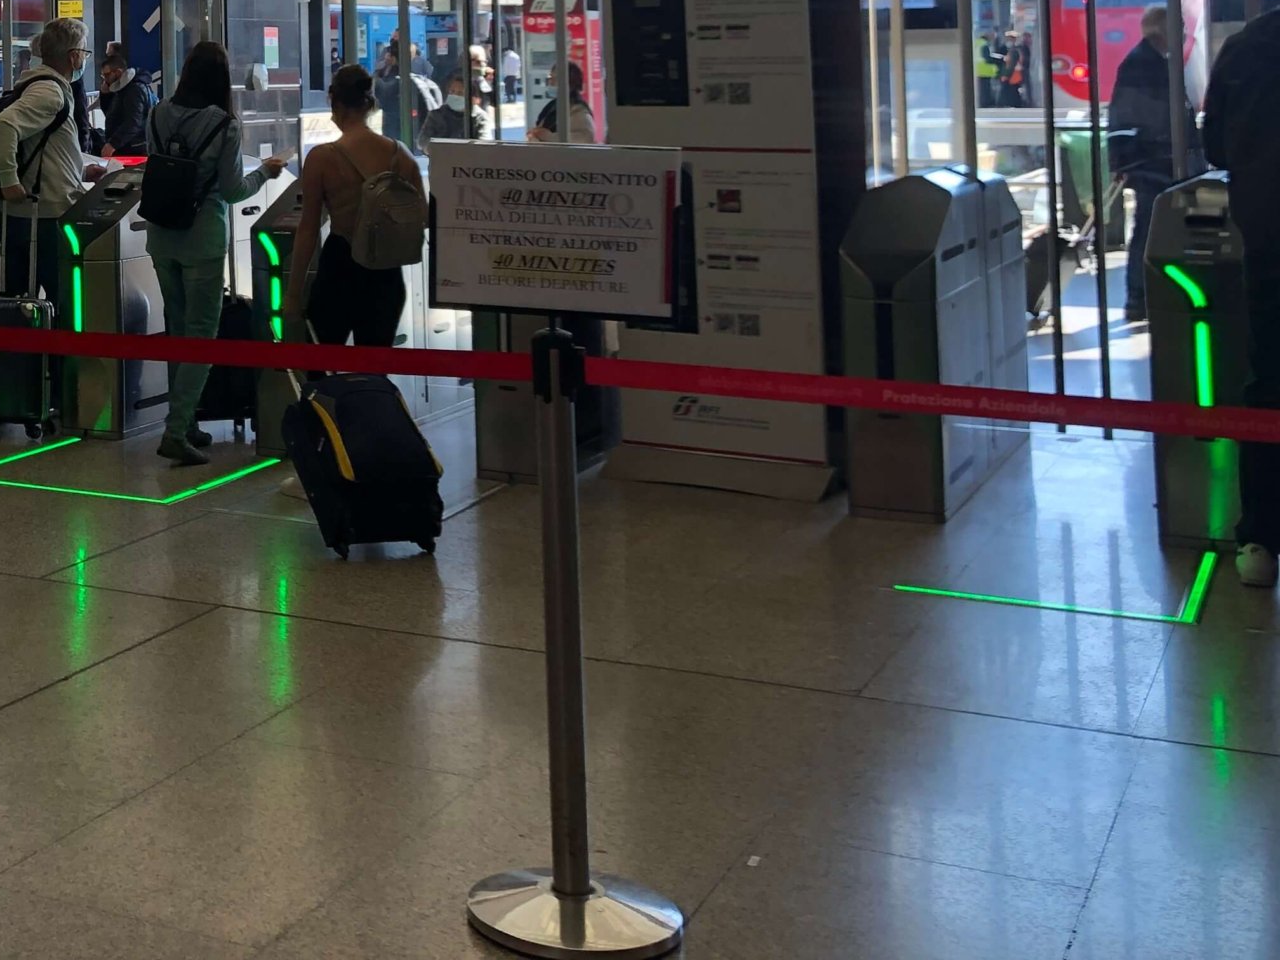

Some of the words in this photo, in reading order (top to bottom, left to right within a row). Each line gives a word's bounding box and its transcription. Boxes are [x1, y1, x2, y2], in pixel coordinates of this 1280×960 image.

[451, 166, 537, 182] INGRESSO
[540, 170, 658, 188] CONSENTITO
[501, 189, 523, 204] 40
[526, 189, 609, 208] MINUTI
[455, 208, 504, 223] PRIMA
[508, 210, 563, 227] DELLA
[567, 213, 654, 231] PARTENZA
[470, 233, 557, 250] ENTRANCE
[560, 237, 638, 253] ALLOWED
[492, 253, 517, 268] 40
[520, 256, 617, 274] MINUTES
[478, 274, 538, 290] BEFORE
[540, 278, 629, 294] DEPARTURE
[882, 389, 973, 410] Protezione
[978, 394, 1066, 418] Aziendale
